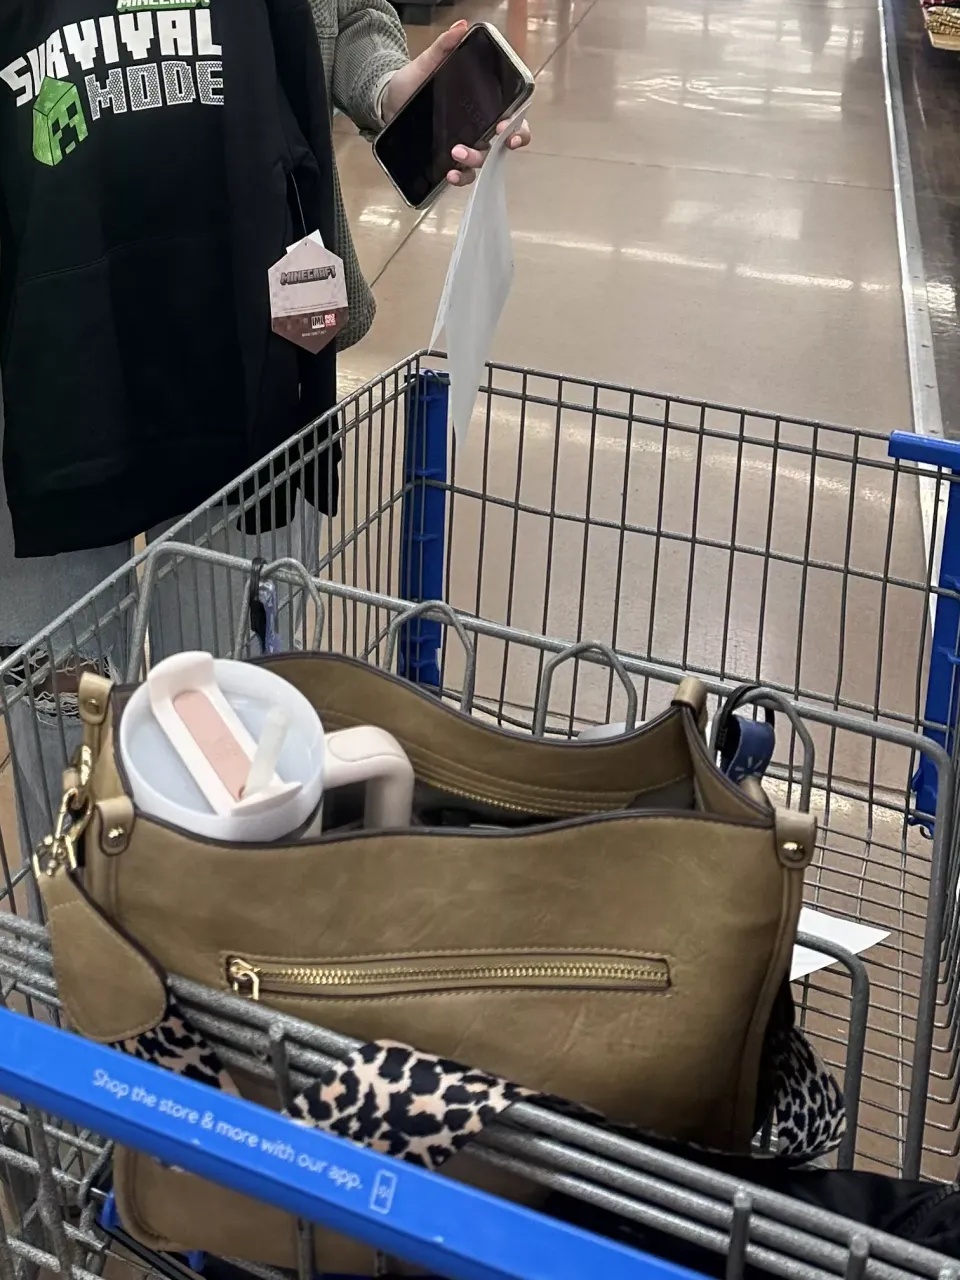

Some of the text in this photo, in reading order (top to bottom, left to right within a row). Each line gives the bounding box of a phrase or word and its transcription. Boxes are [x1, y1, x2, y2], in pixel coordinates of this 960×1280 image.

[84, 61, 224, 120] MODE
[280, 265, 336, 286] MINECRAFT
[93, 1068, 363, 1190] Shop the store & more with our app.
